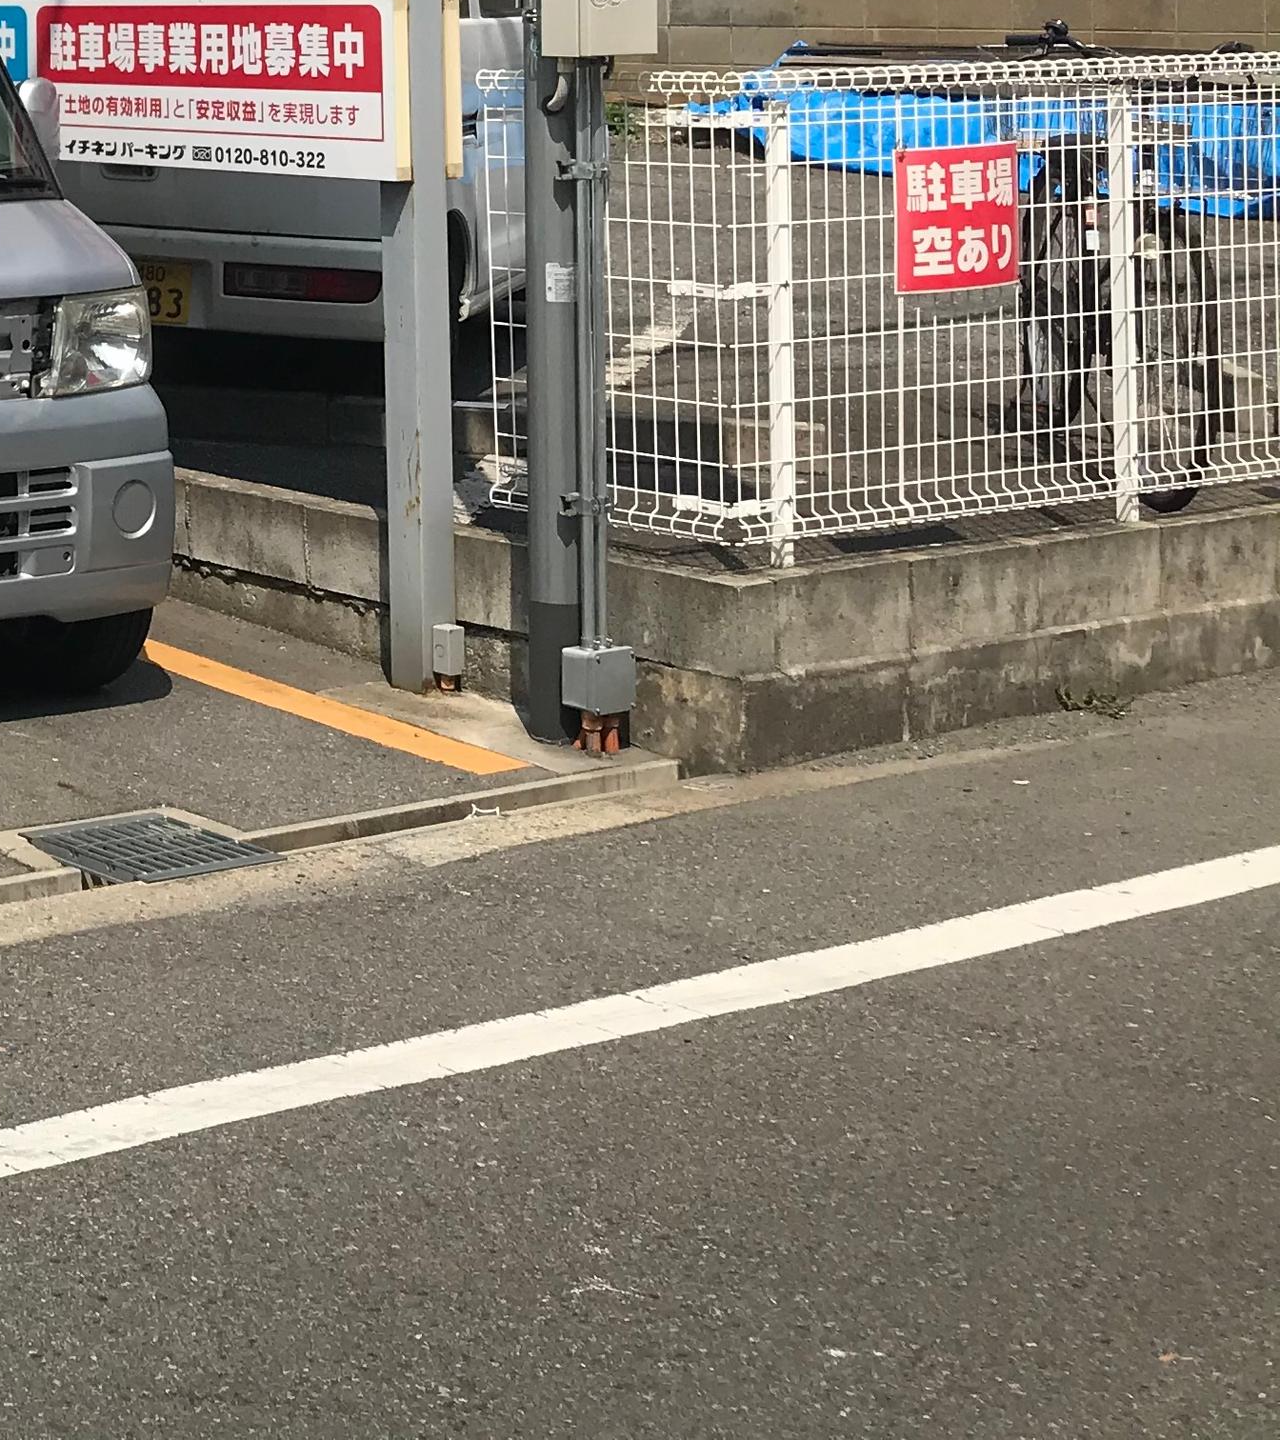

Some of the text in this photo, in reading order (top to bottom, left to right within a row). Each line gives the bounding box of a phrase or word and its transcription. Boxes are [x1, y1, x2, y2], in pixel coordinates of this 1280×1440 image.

[49, 22, 365, 79] 駐車場事業用地募集中
[215, 146, 326, 169] 0120-810-322
[906, 157, 1014, 213] 駐車場
[912, 224, 1013, 277] 空あり
